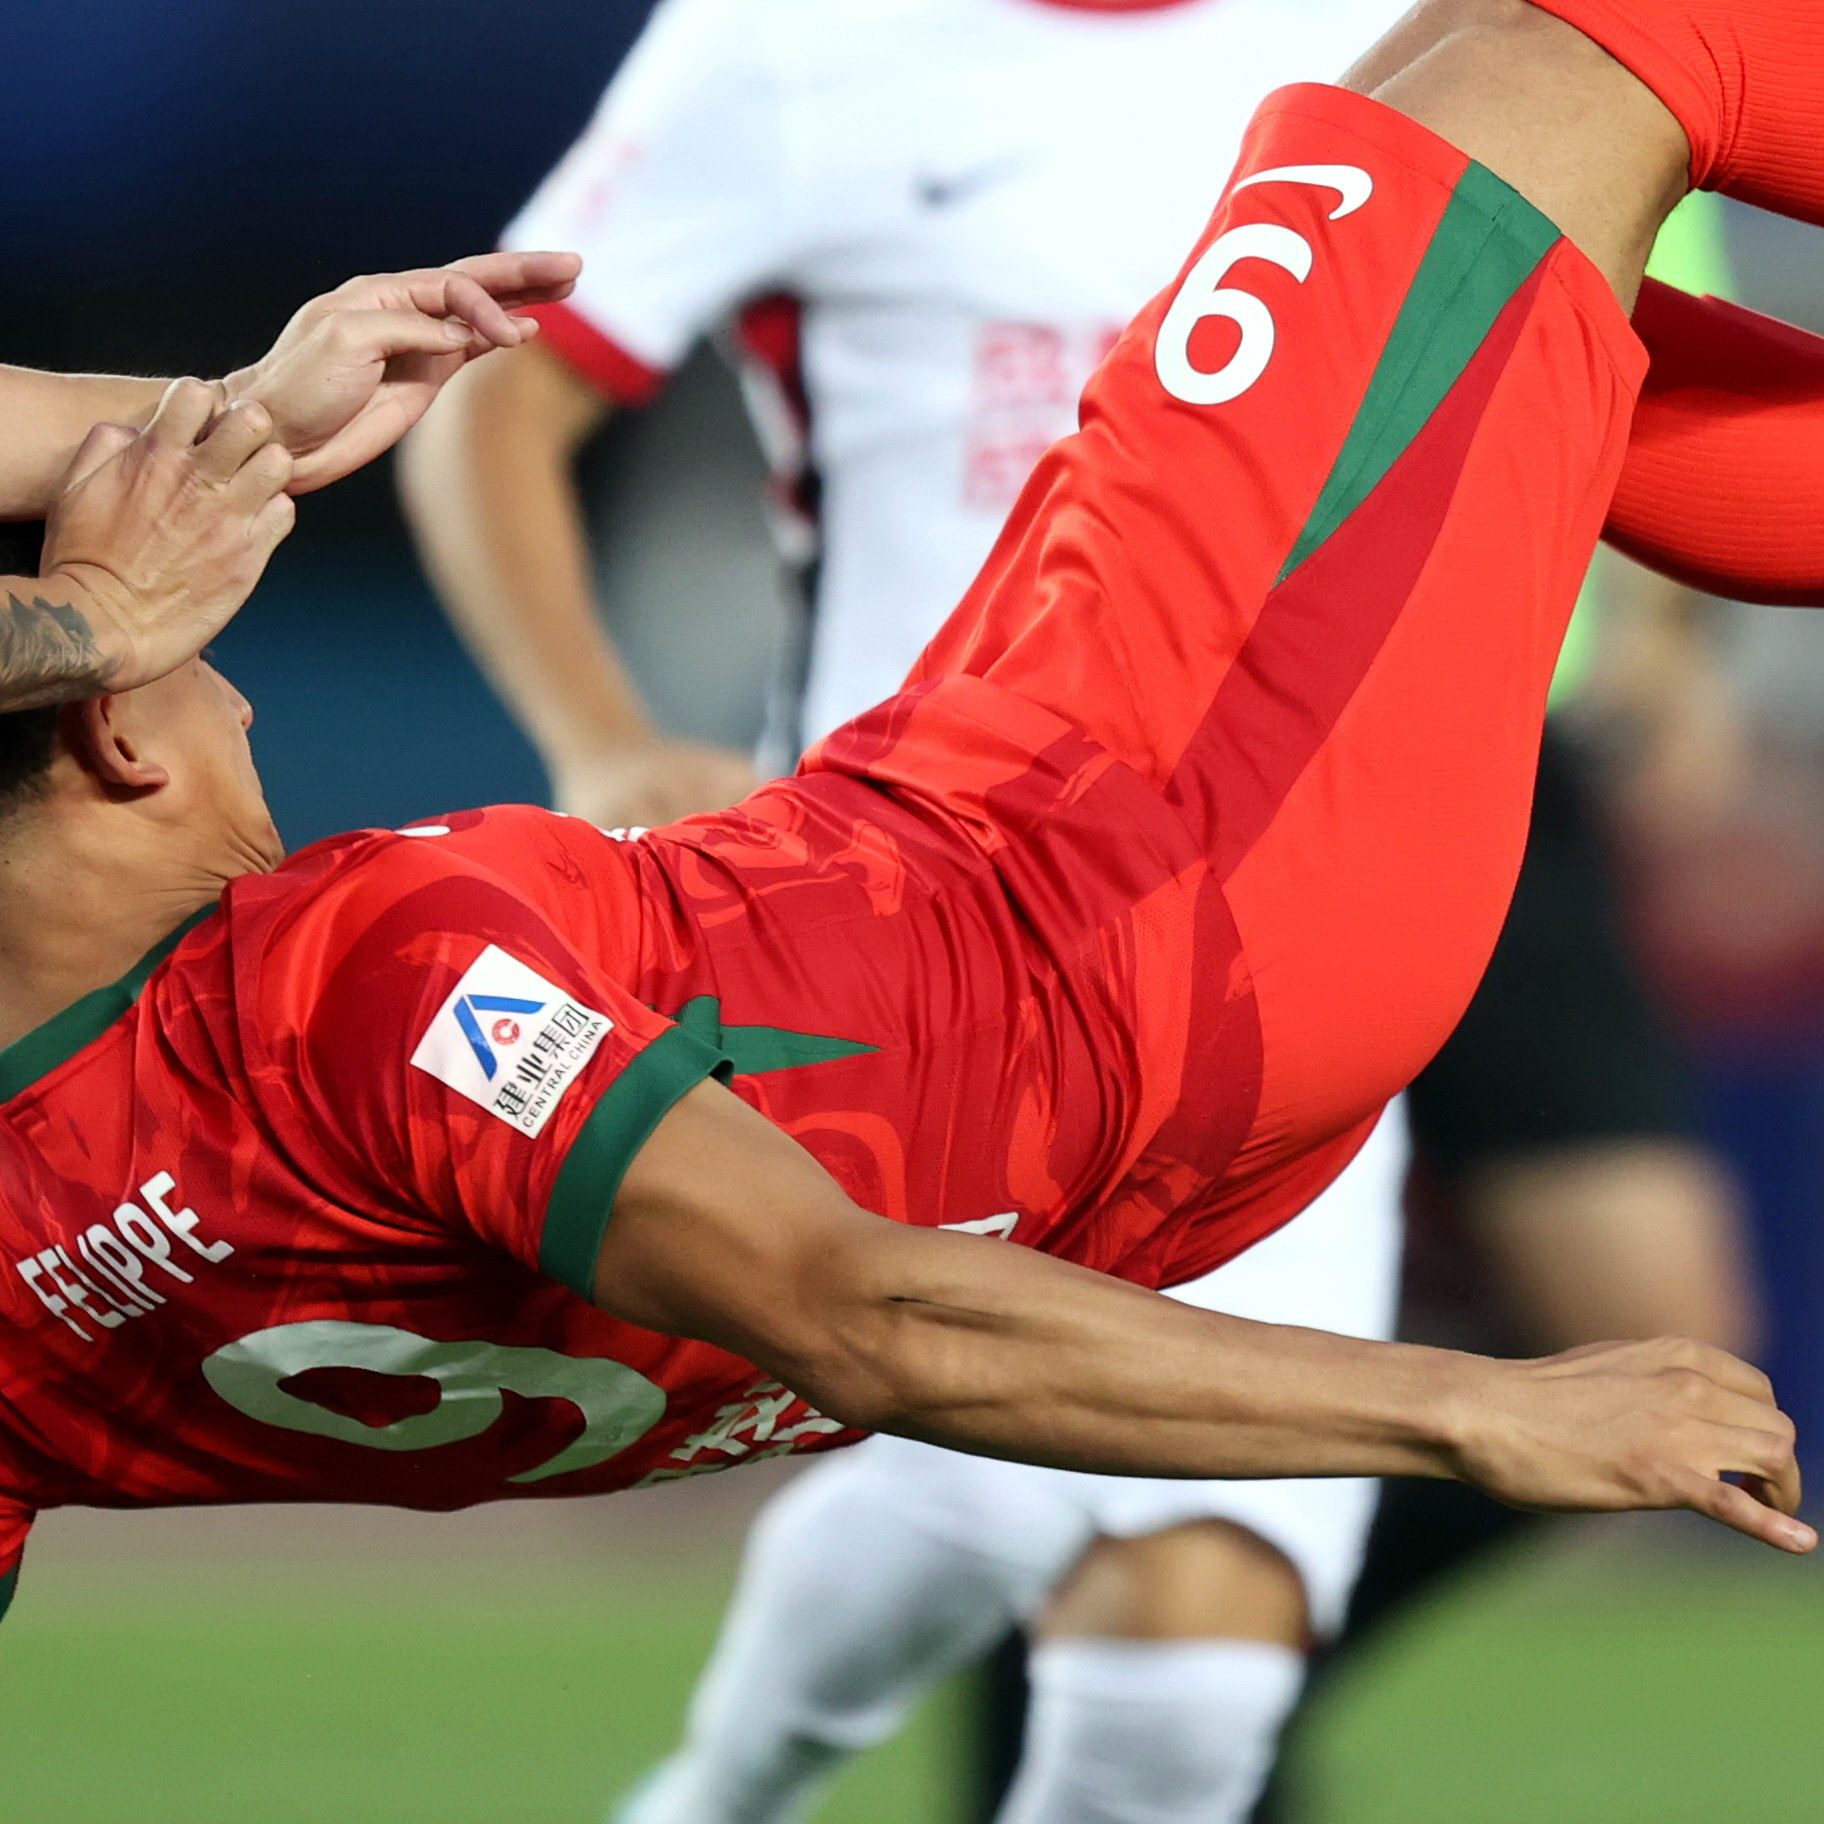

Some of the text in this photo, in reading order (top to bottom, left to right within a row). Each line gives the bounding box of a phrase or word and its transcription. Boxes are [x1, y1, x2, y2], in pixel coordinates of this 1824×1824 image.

[1155, 223, 1313, 405] 6
[493, 1003, 589, 1120] 建业集团
[522, 1020, 603, 1128] CENTRAL CHINA
[16, 1170, 235, 1342] FELIPPE
[201, 1320, 666, 1484] 9
